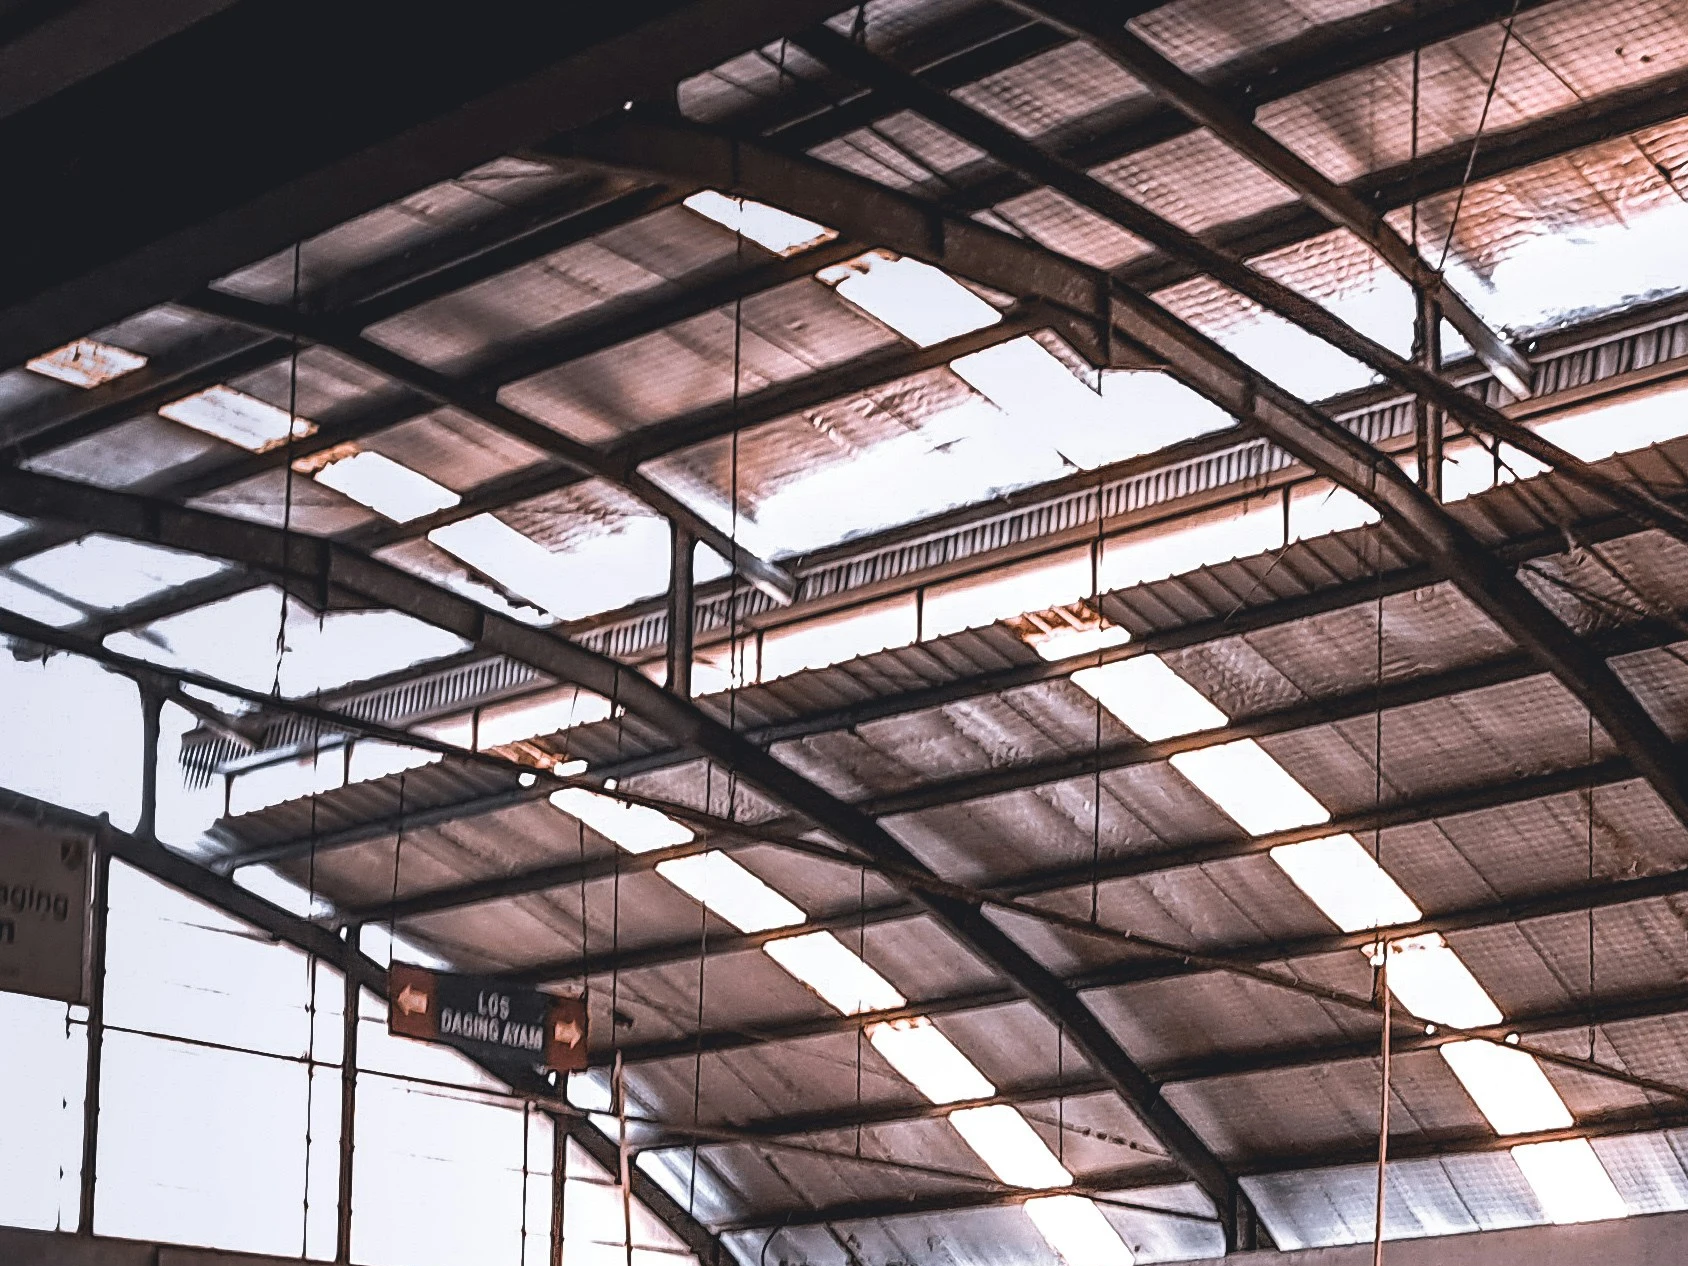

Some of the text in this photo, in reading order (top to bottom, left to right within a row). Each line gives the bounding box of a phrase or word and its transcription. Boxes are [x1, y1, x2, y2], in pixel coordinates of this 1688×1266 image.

[478, 990, 510, 1020] LOS
[441, 1008, 543, 1053] DAGING AYAM
